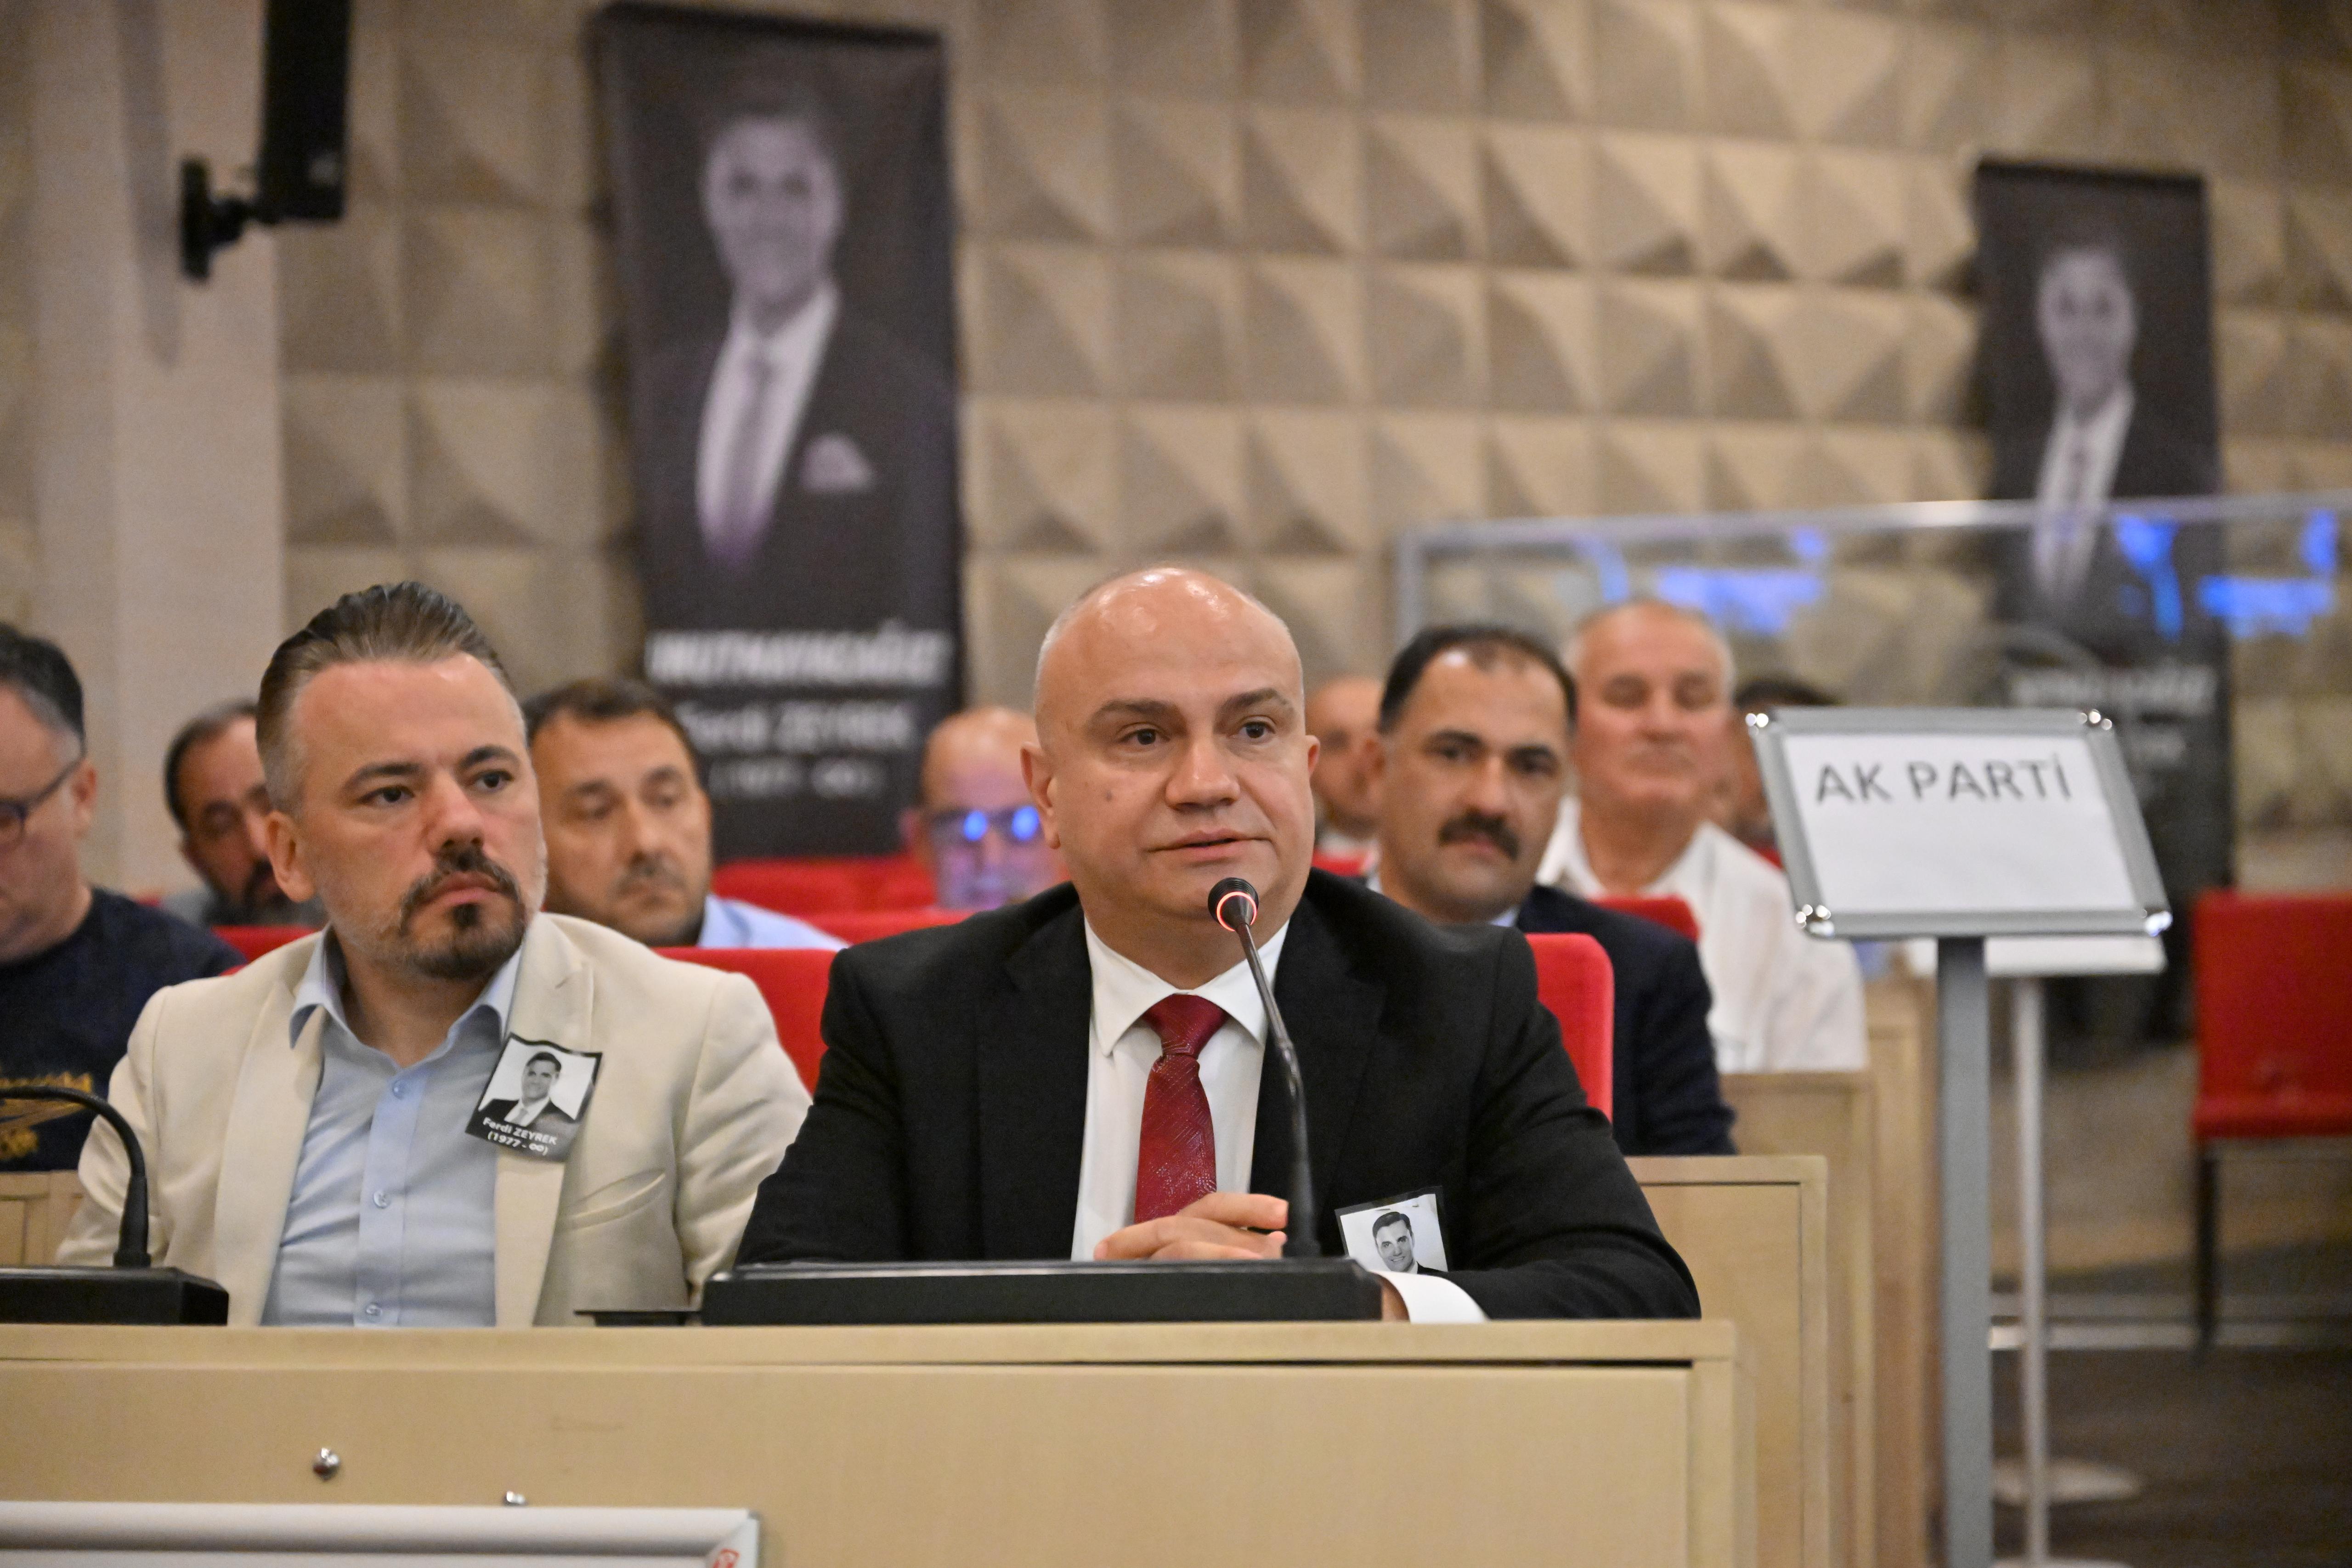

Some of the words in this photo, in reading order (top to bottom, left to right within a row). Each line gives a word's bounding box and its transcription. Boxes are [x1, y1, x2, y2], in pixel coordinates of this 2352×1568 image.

[1815, 761, 1893, 804] AK
[1906, 753, 2073, 801] PARTİ
[488, 1131, 521, 1148] (1977
[513, 1127, 557, 1145] ZEYREK
